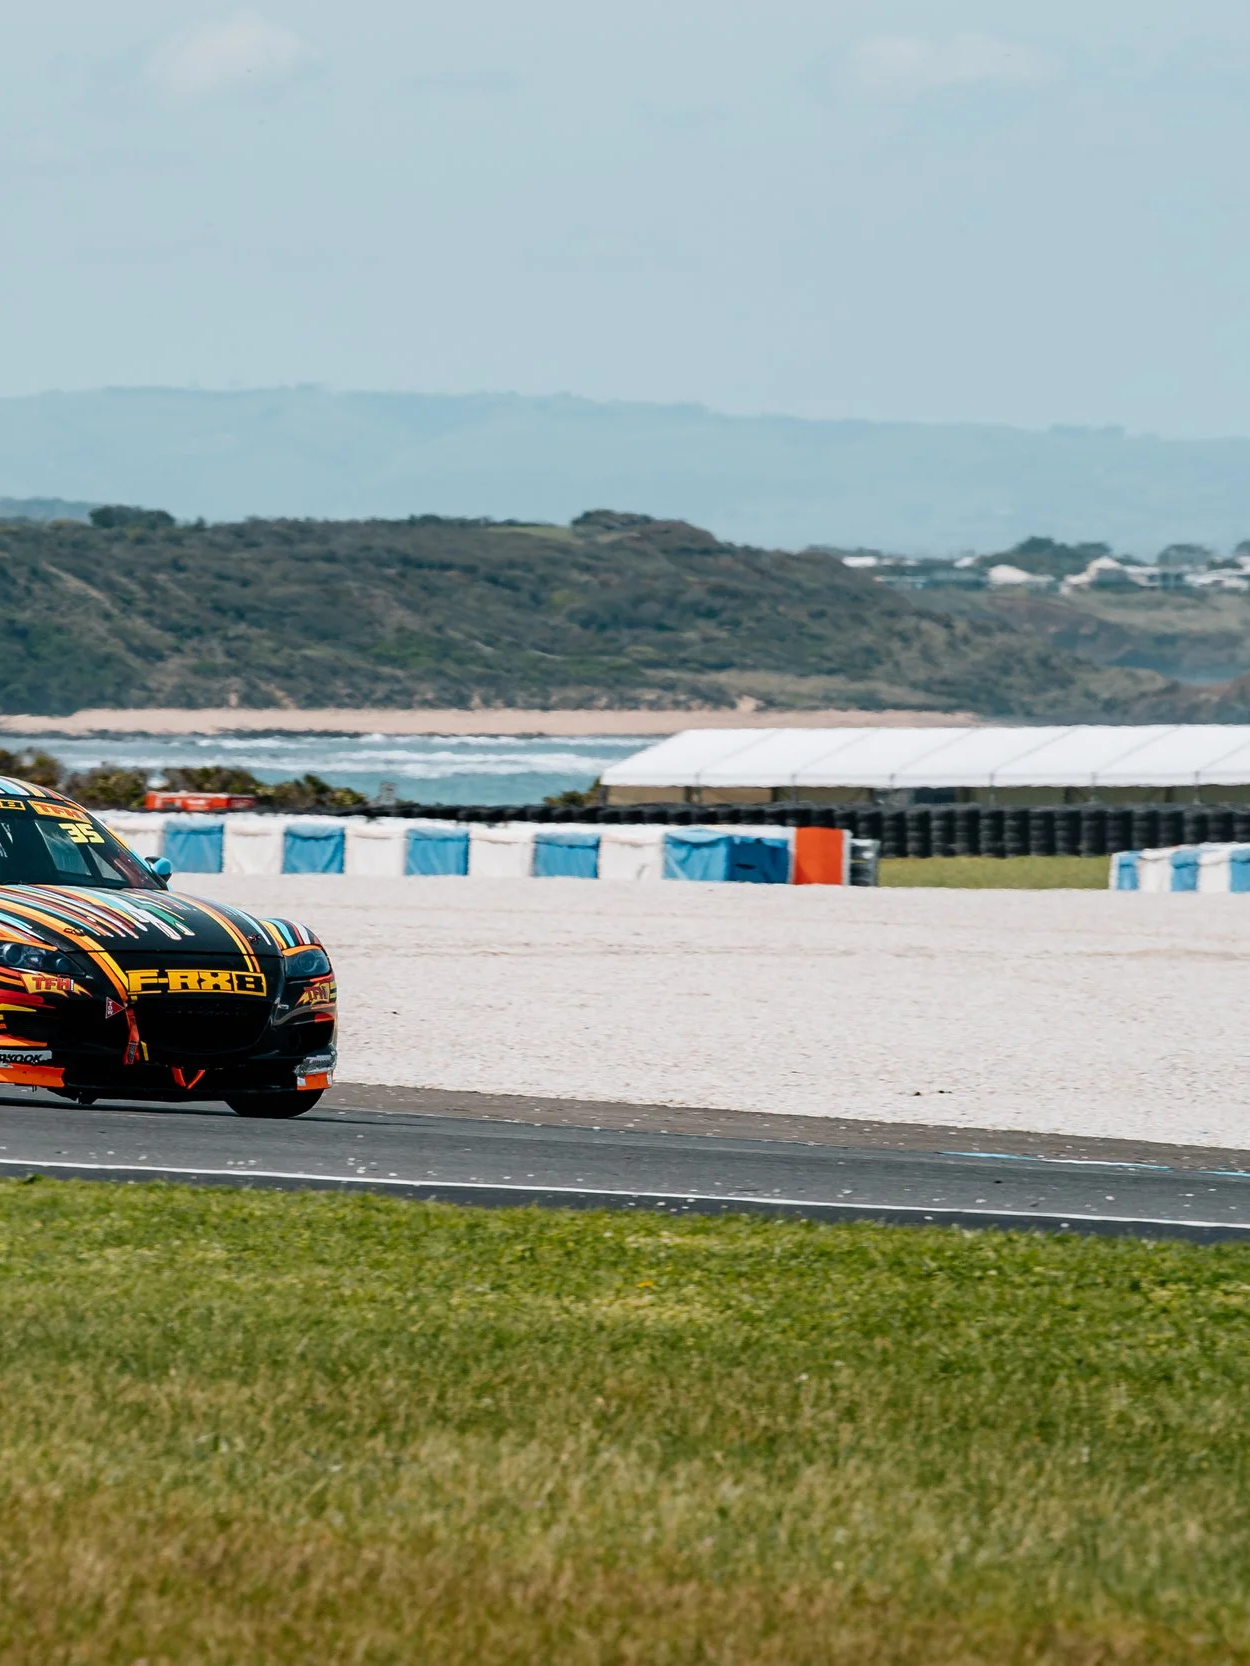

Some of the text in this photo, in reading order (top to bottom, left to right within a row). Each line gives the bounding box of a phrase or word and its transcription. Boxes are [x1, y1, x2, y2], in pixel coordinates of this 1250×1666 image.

[33, 803, 83, 820] TFH
[58, 823, 105, 843] 35
[31, 976, 70, 991] TFH
[125, 969, 267, 997] F-RX8
